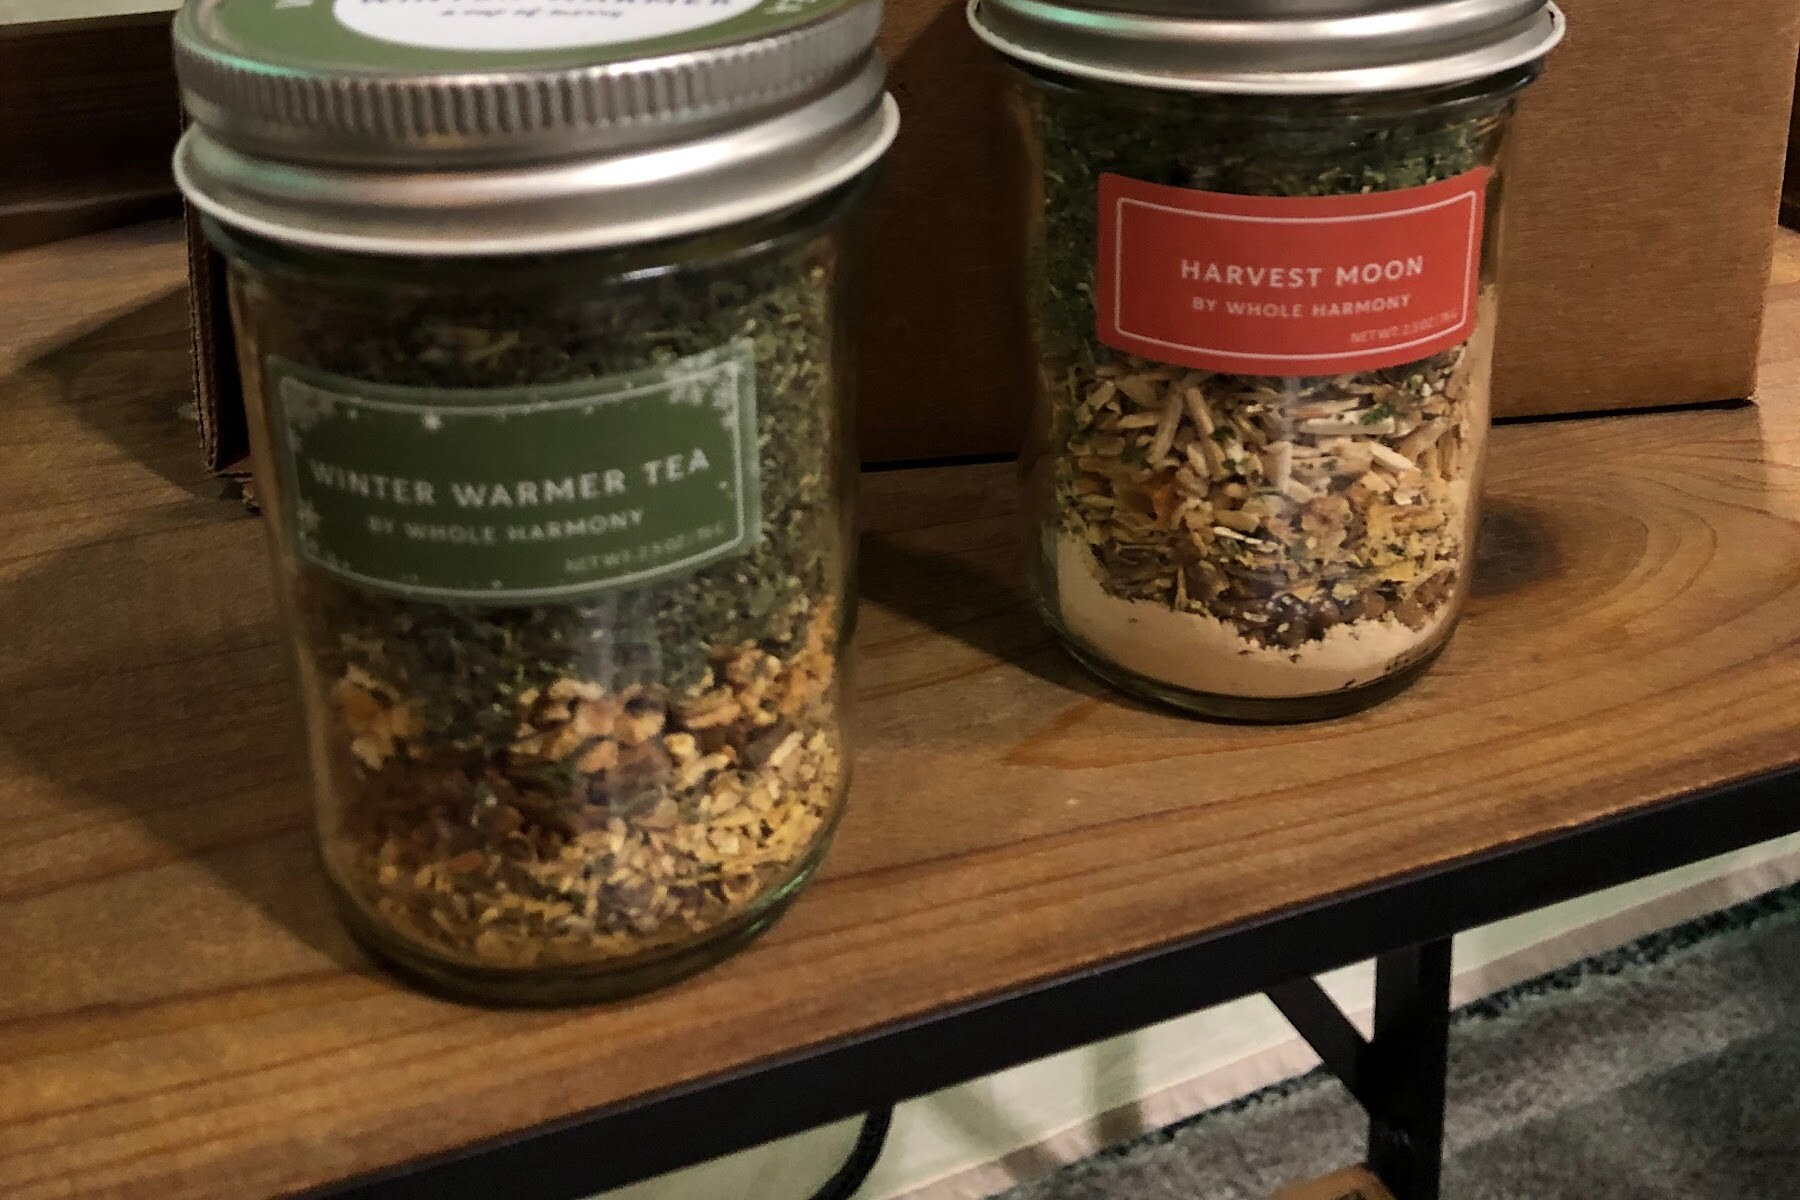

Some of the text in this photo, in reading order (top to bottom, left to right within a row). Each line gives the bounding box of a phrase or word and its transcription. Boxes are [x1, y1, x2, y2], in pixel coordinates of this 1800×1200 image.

[1180, 254, 1424, 289] HARVEST MOON
[1191, 292, 1411, 318] BY WHOLE HARMONY
[308, 446, 711, 509] WINTER WARMER TEA
[367, 508, 645, 545] BY WHOLE HARMONY
